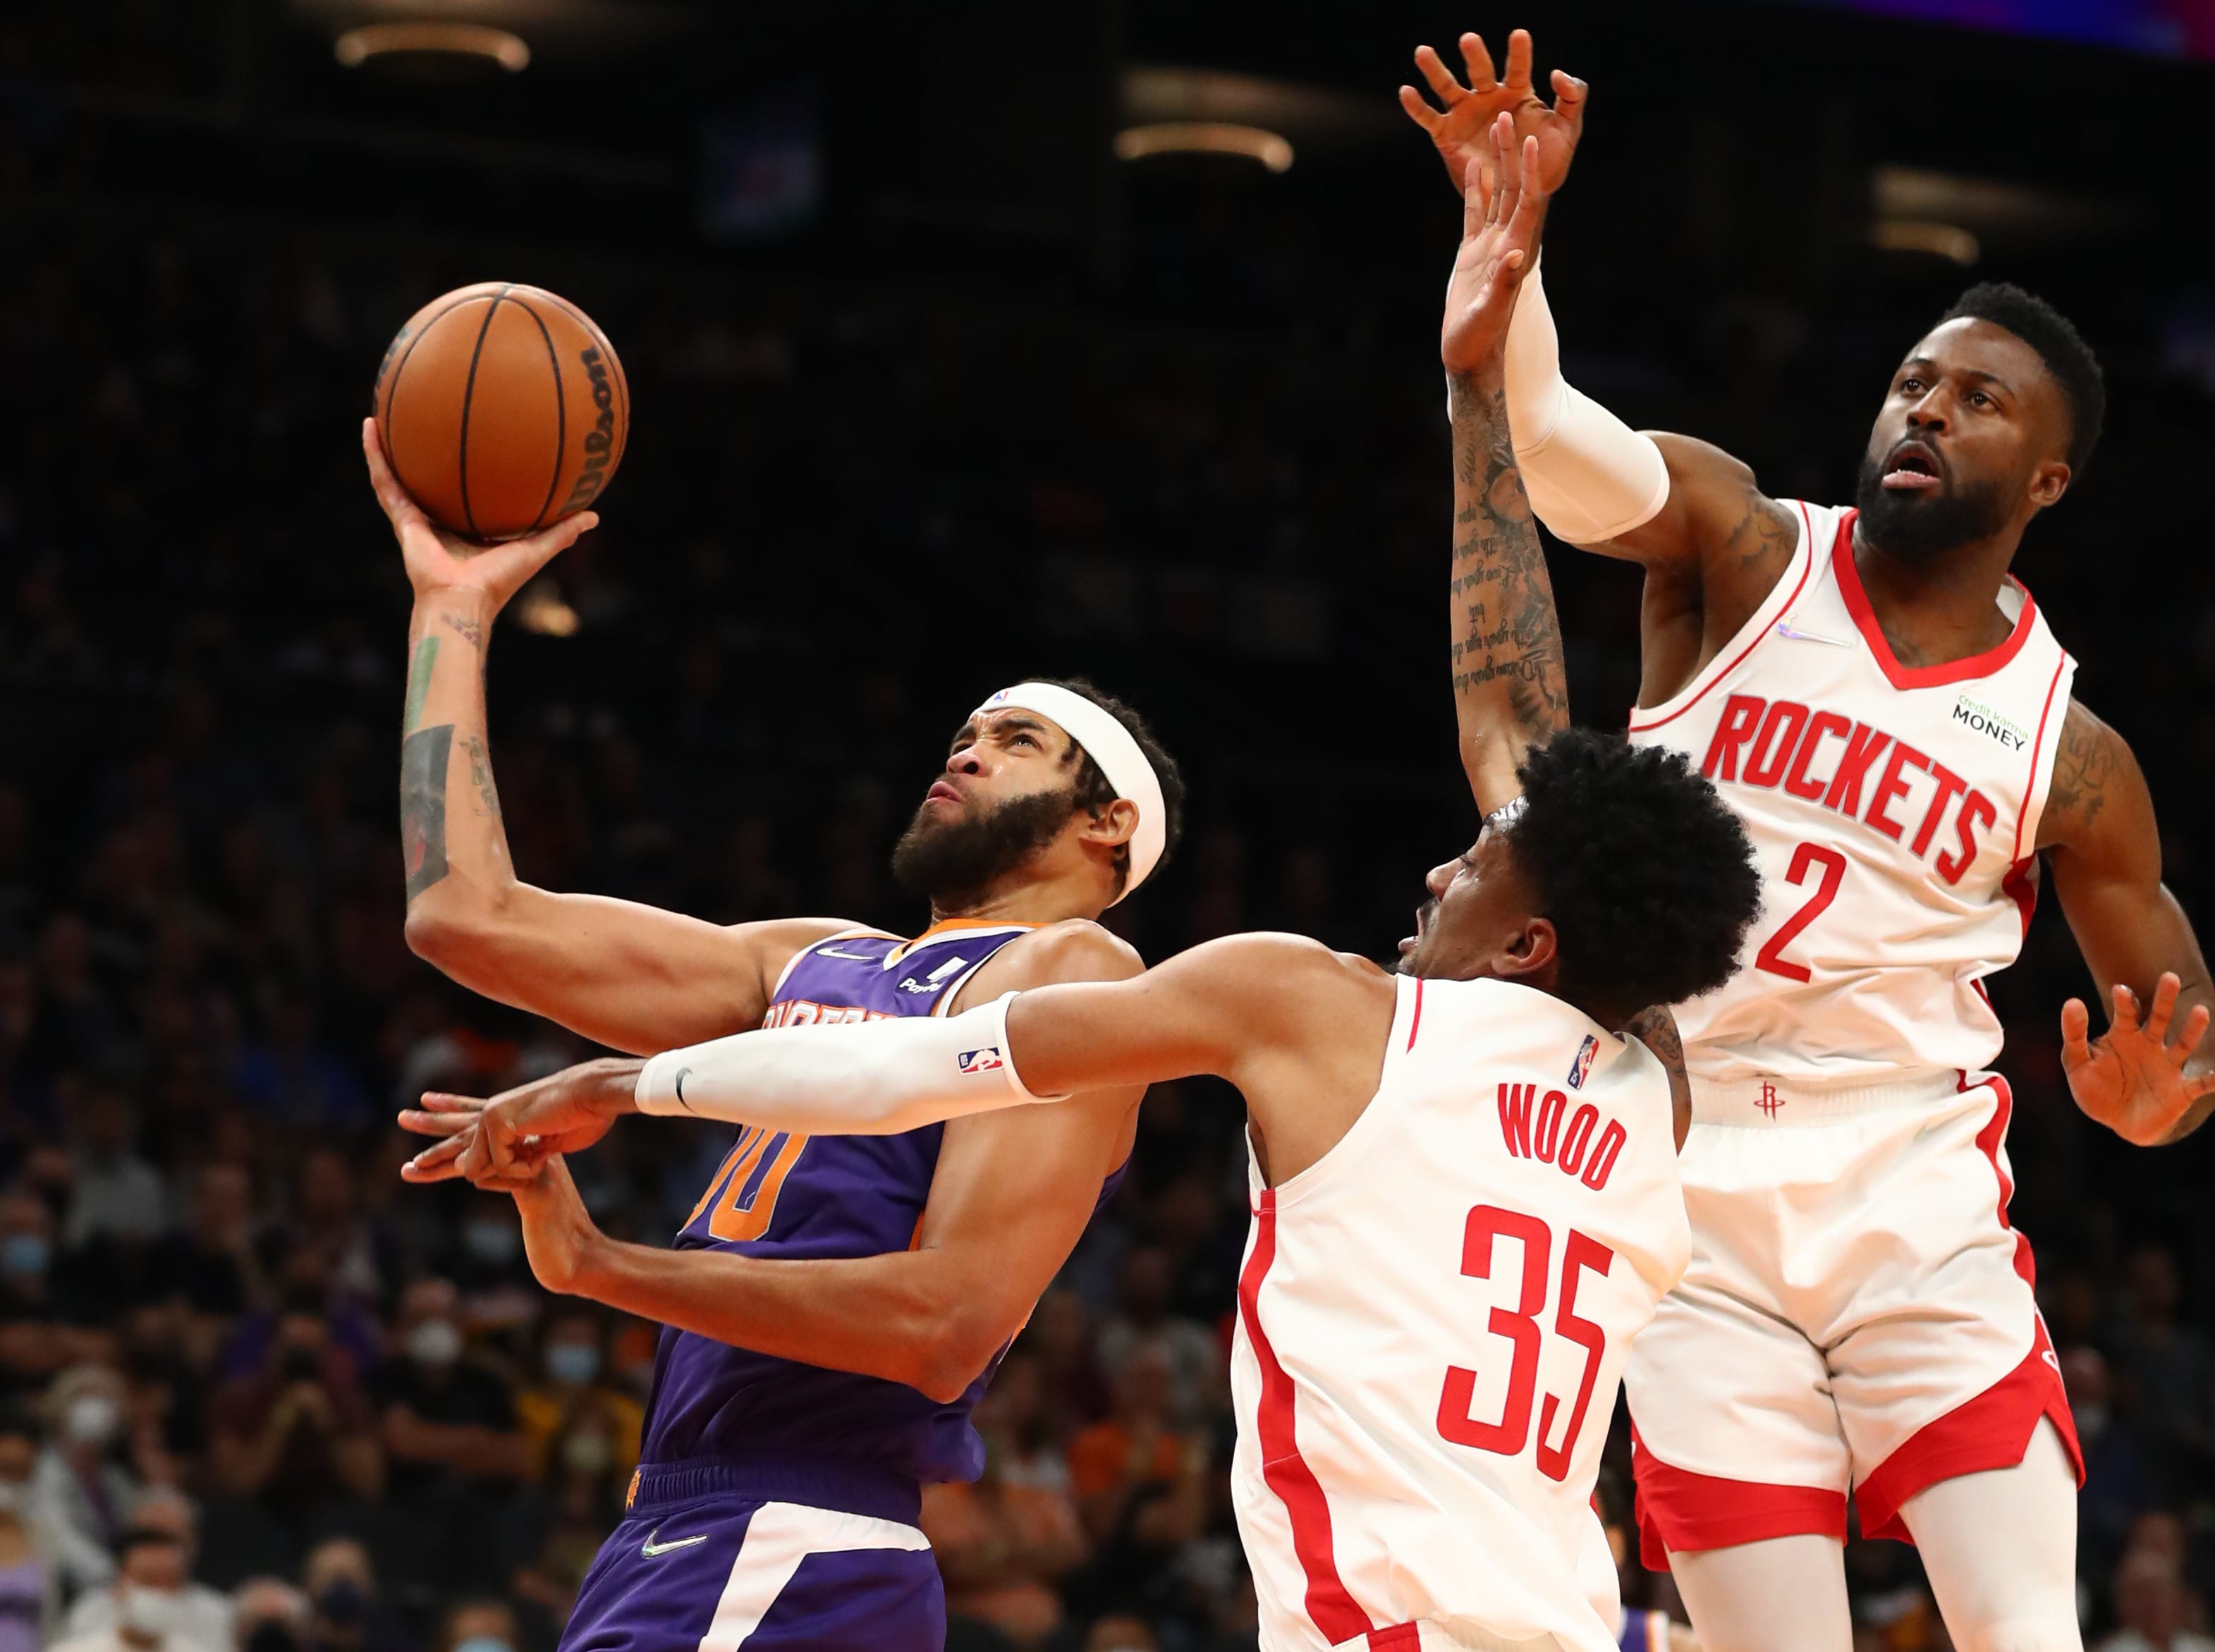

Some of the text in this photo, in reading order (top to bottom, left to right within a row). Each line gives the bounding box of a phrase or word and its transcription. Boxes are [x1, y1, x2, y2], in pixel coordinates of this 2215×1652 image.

[1953, 704, 2025, 751] MONEY
[1959, 695, 2028, 740] credit karma
[1702, 693, 1997, 887] ROCKETS
[1755, 842, 1848, 984] 2
[1498, 1083, 1627, 1192] WOOD
[1436, 1204, 1615, 1483] 35
